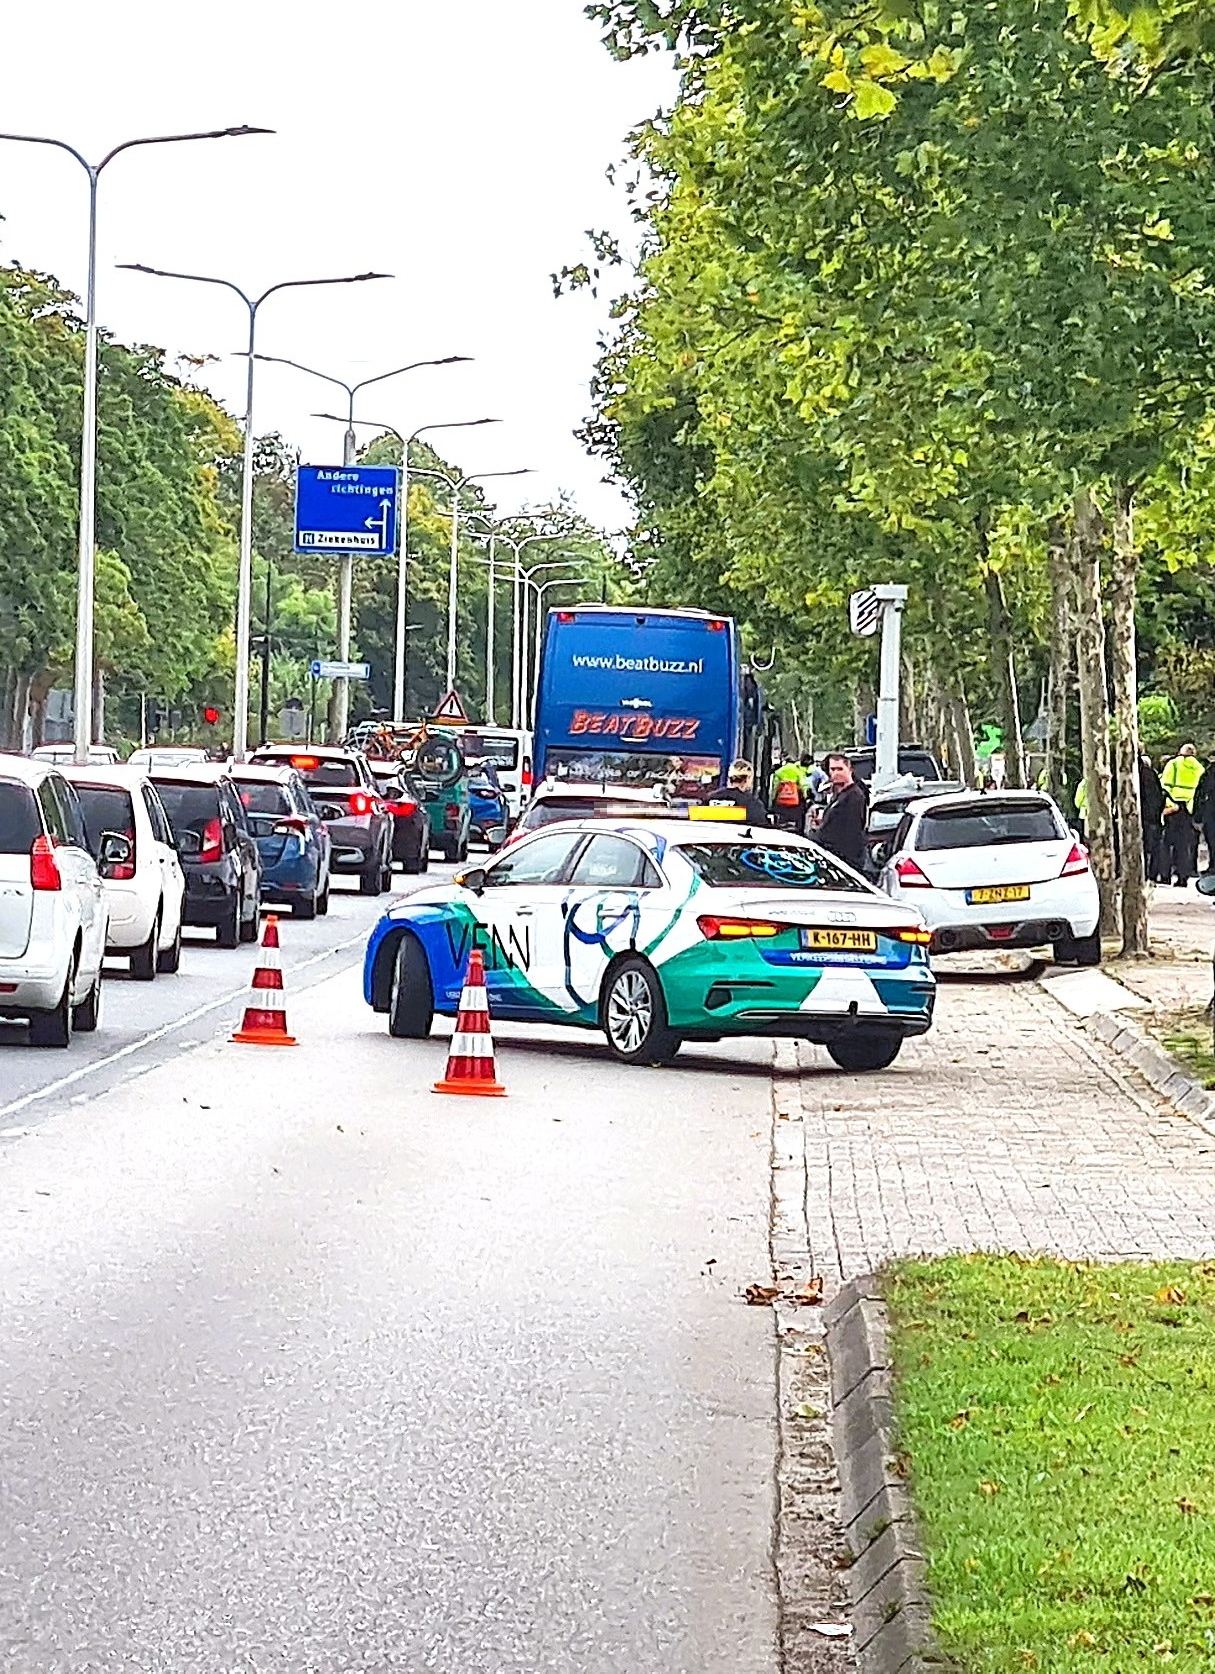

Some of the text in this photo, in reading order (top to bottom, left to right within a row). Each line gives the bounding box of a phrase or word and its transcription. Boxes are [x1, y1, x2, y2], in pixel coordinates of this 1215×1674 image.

[316, 470, 360, 482] Andere
[330, 483, 394, 497] richtingen
[317, 534, 376, 545] Ziekenhuis
[572, 653, 704, 674] www.beatbuzz.nl
[812, 931, 871, 947] K-167-HH
[445, 922, 531, 973] VENN
